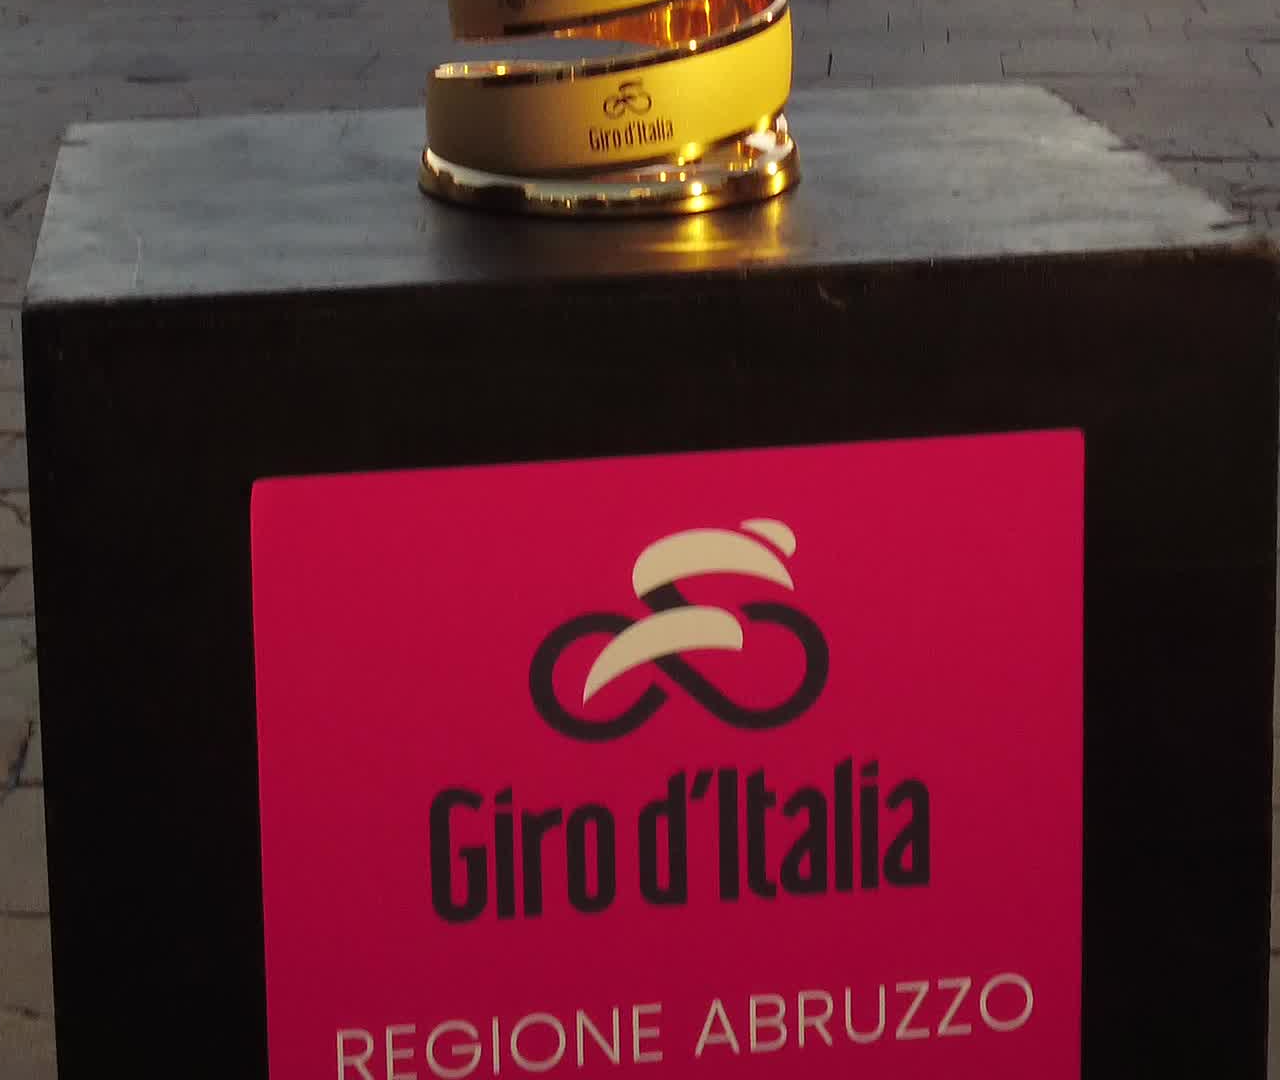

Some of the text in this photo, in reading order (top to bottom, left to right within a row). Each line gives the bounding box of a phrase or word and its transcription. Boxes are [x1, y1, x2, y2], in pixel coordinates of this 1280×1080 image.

[588, 116, 673, 151] Giro d'Italia
[428, 754, 932, 925] Giro d'Italia
[335, 973, 1035, 1080] REGIONE ABRUZZO
